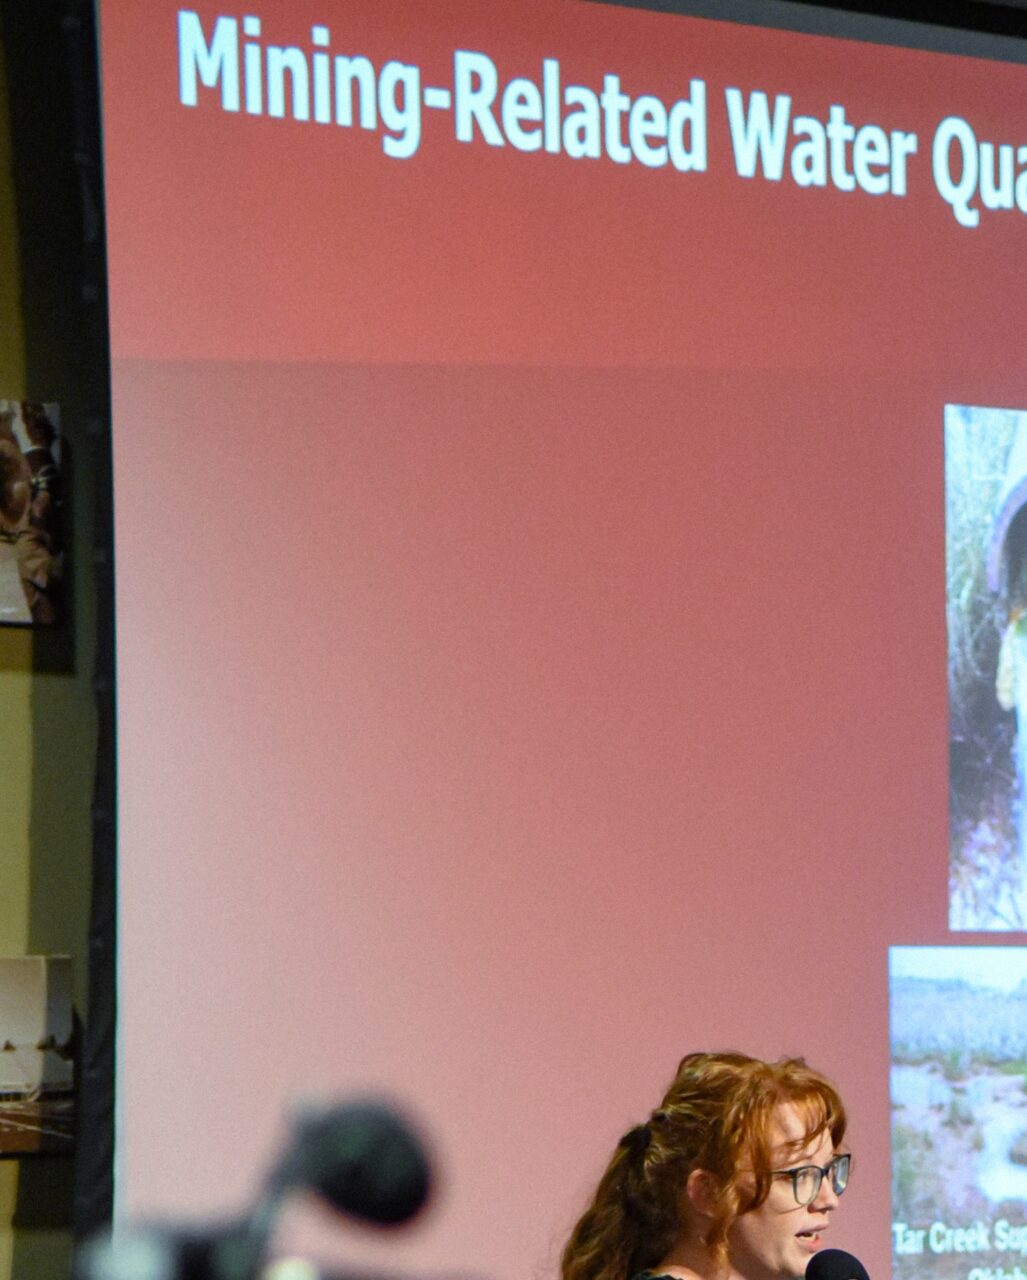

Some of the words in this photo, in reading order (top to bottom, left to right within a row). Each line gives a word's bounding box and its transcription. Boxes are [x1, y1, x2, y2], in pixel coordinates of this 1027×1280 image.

[178, 9, 707, 172] Mining-Related
[725, 87, 917, 197] Water
[893, 1221, 925, 1255] Tar
[929, 1221, 990, 1253] Creek
